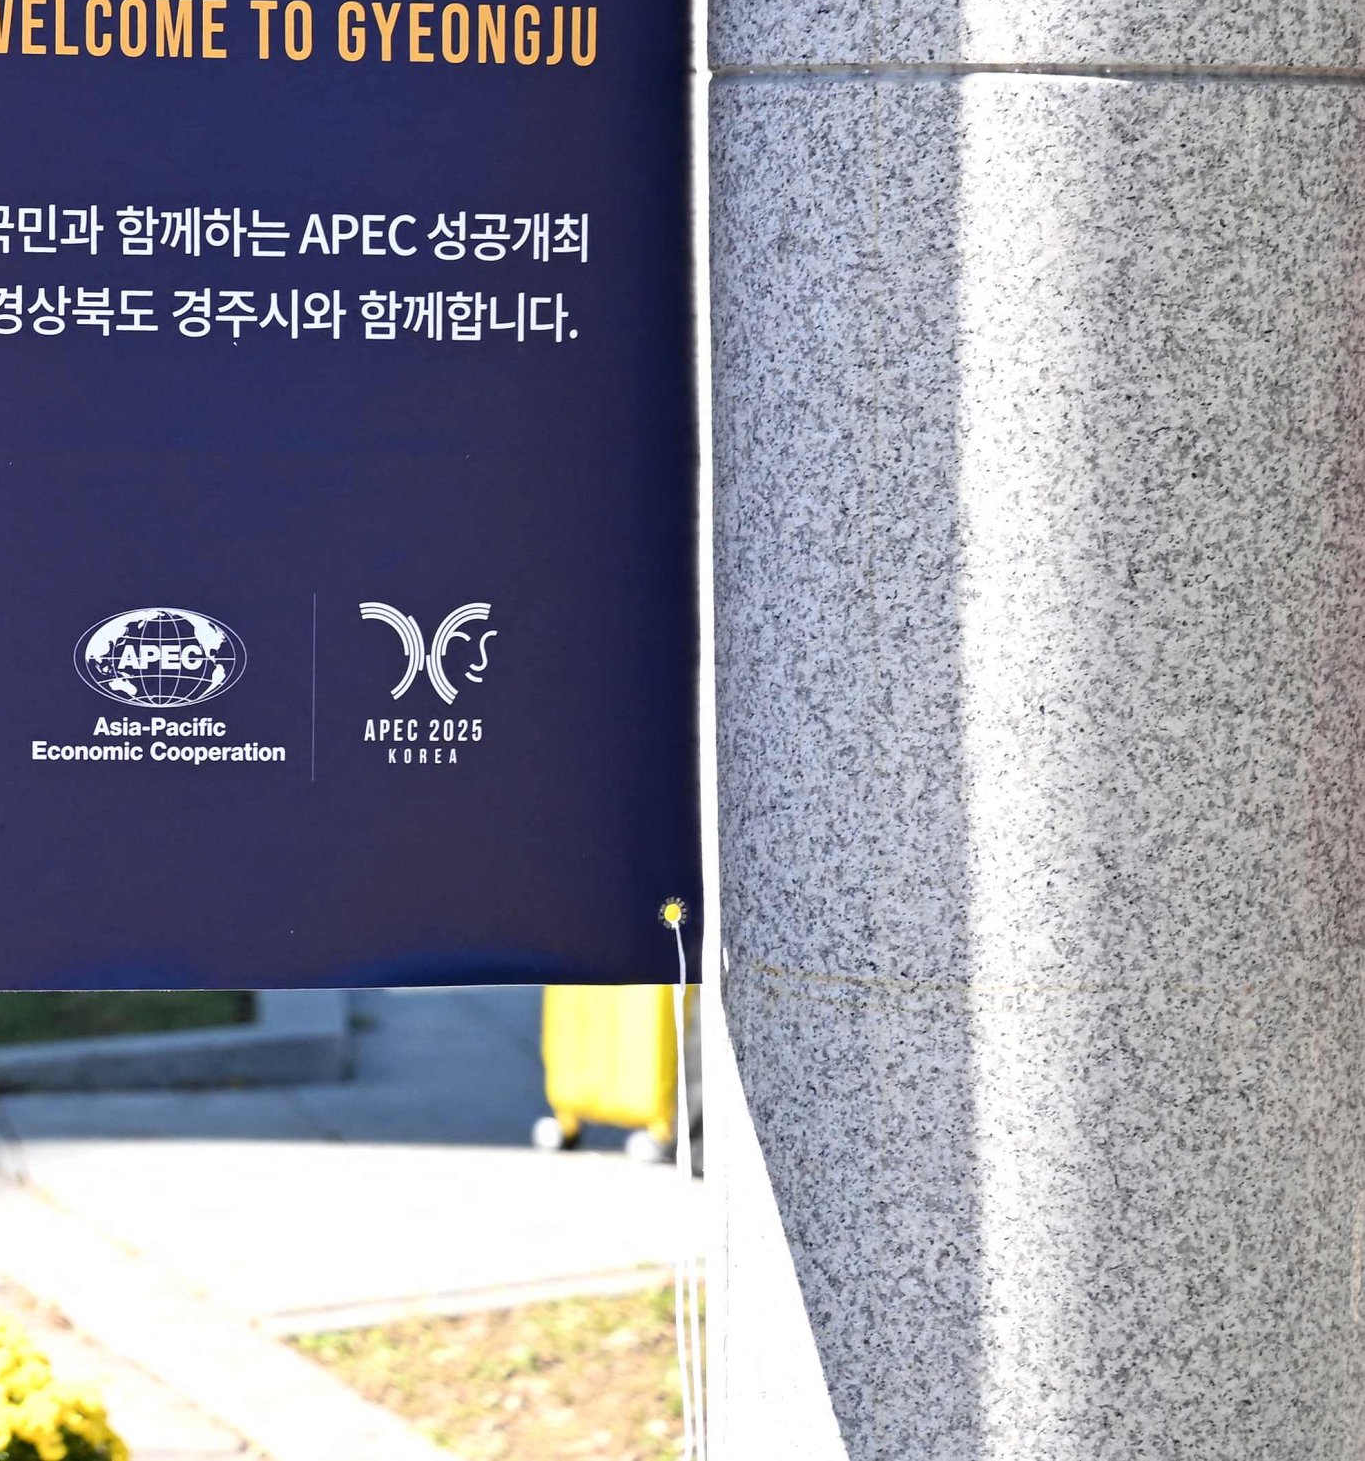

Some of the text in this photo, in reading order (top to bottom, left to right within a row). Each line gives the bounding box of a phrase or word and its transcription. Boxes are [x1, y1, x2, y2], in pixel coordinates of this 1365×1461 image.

[250, 0, 314, 62] TO
[337, 1, 598, 68] GYEONGJU
[115, 205, 292, 259] 함께하는
[298, 212, 419, 259] APEC
[426, 211, 591, 264] 성공개최
[171, 288, 348, 340] 경주시와
[358, 290, 579, 343] 함께합니다.
[116, 644, 206, 673] APEC
[92, 716, 227, 738] Asia-Pacific
[363, 718, 484, 743] APEC 2025
[31, 740, 287, 766] Economic Cooperation
[388, 747, 459, 765] KOREA
